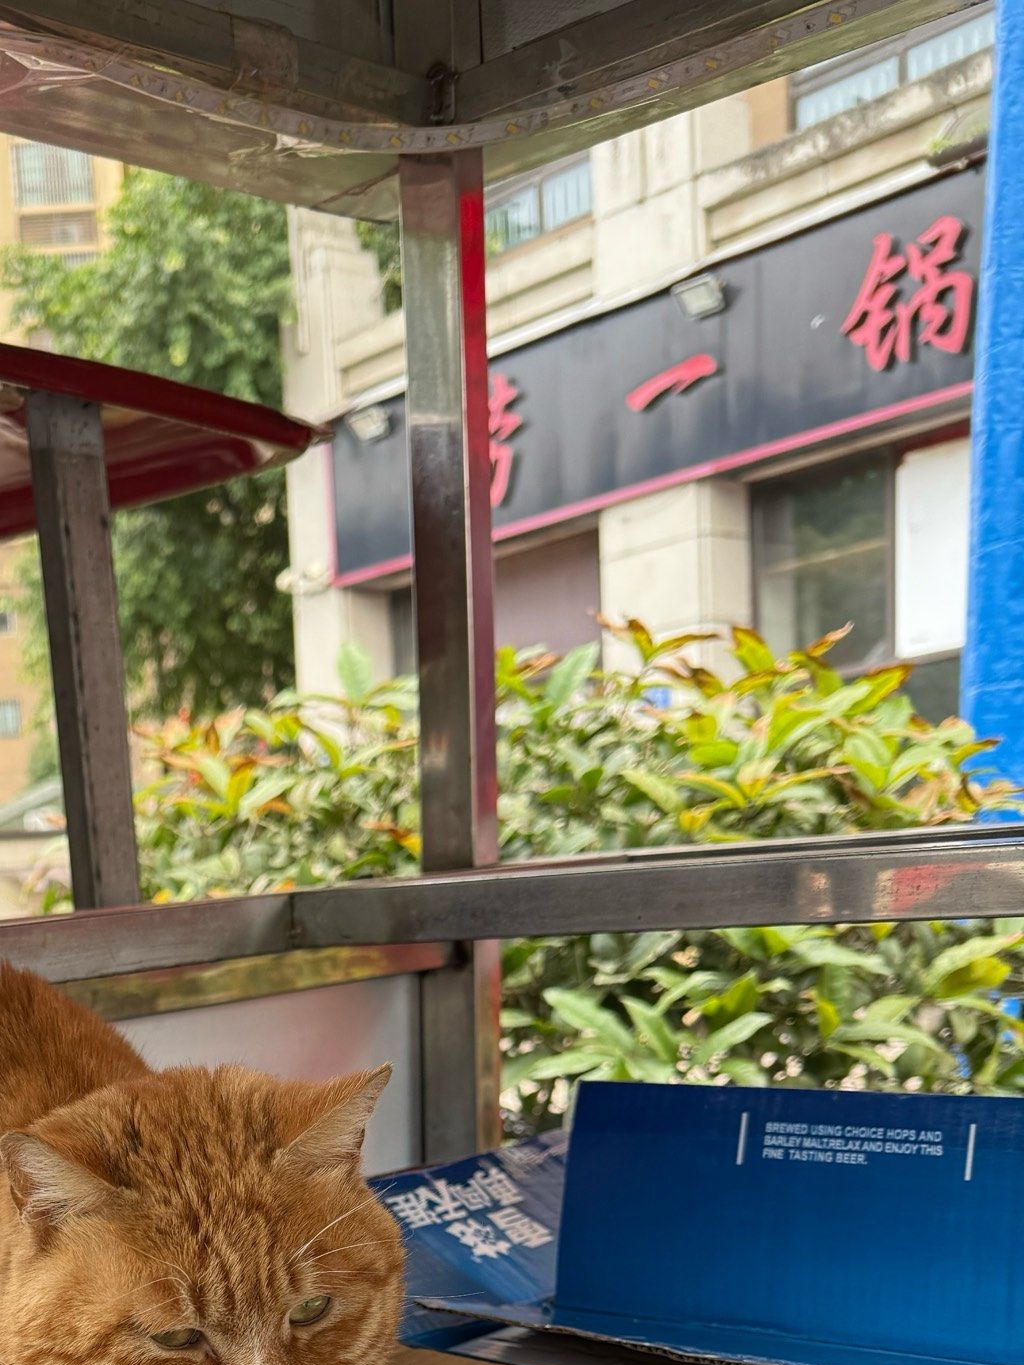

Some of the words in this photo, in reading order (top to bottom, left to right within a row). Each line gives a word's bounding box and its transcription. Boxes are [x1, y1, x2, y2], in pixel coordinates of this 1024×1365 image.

[765, 1121, 808, 1135] BREWED
[811, 1123, 842, 1137] USING
[844, 1125, 884, 1139] CHOICE
[886, 1127, 916, 1140] HOPS
[918, 1130, 942, 1142] AND
[764, 1134, 801, 1147] BARLEY
[861, 1141, 883, 1153] AND
[884, 1142, 919, 1155] ENJOY
[920, 1144, 944, 1156] THIS
[762, 1147, 784, 1160] FINE
[788, 1149, 833, 1163] TASTING
[835, 1152, 868, 1165] BEER.
[445, 1206, 554, 1259] 雪花
